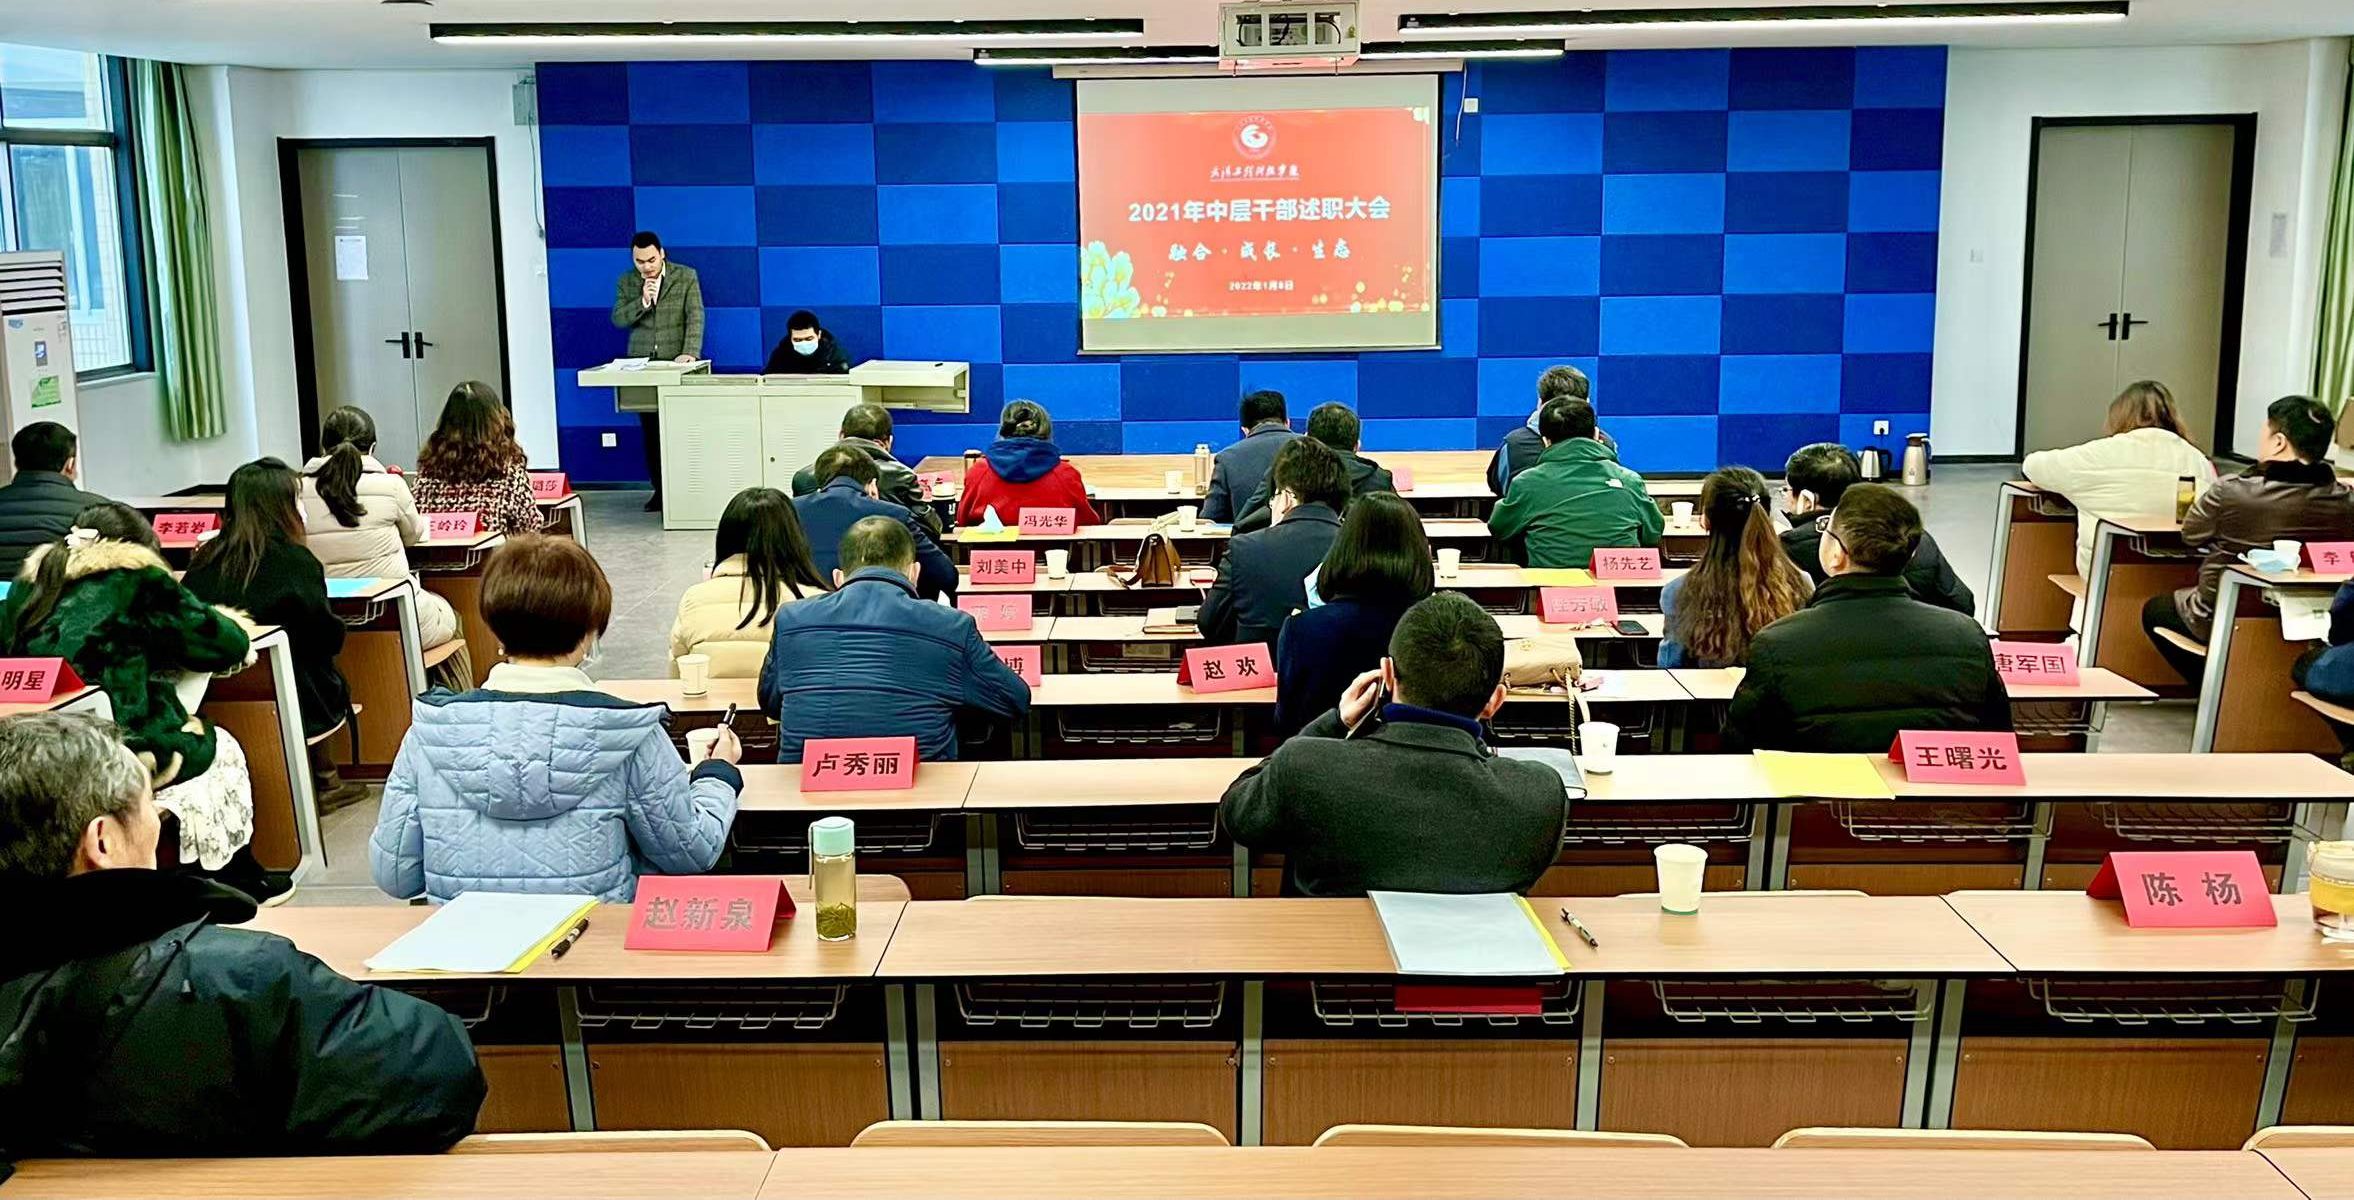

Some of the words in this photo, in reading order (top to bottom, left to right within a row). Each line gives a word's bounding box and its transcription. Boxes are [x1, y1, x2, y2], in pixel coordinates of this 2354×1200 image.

[1128, 195, 1391, 223] 2021年中层干部述职大会
[1024, 515, 1068, 527] 冯光华
[976, 559, 1027, 574] 刘美中
[1603, 556, 1654, 571] 杨先艺
[1203, 656, 1259, 680] 赵欢
[1995, 653, 2066, 674] 唐军国
[0, 670, 46, 690] 明星
[812, 752, 900, 777] 卢秀丽
[1915, 746, 2007, 770] 王曙光
[2141, 872, 2242, 906] 陈杨
[643, 896, 753, 931] 赵新泉
